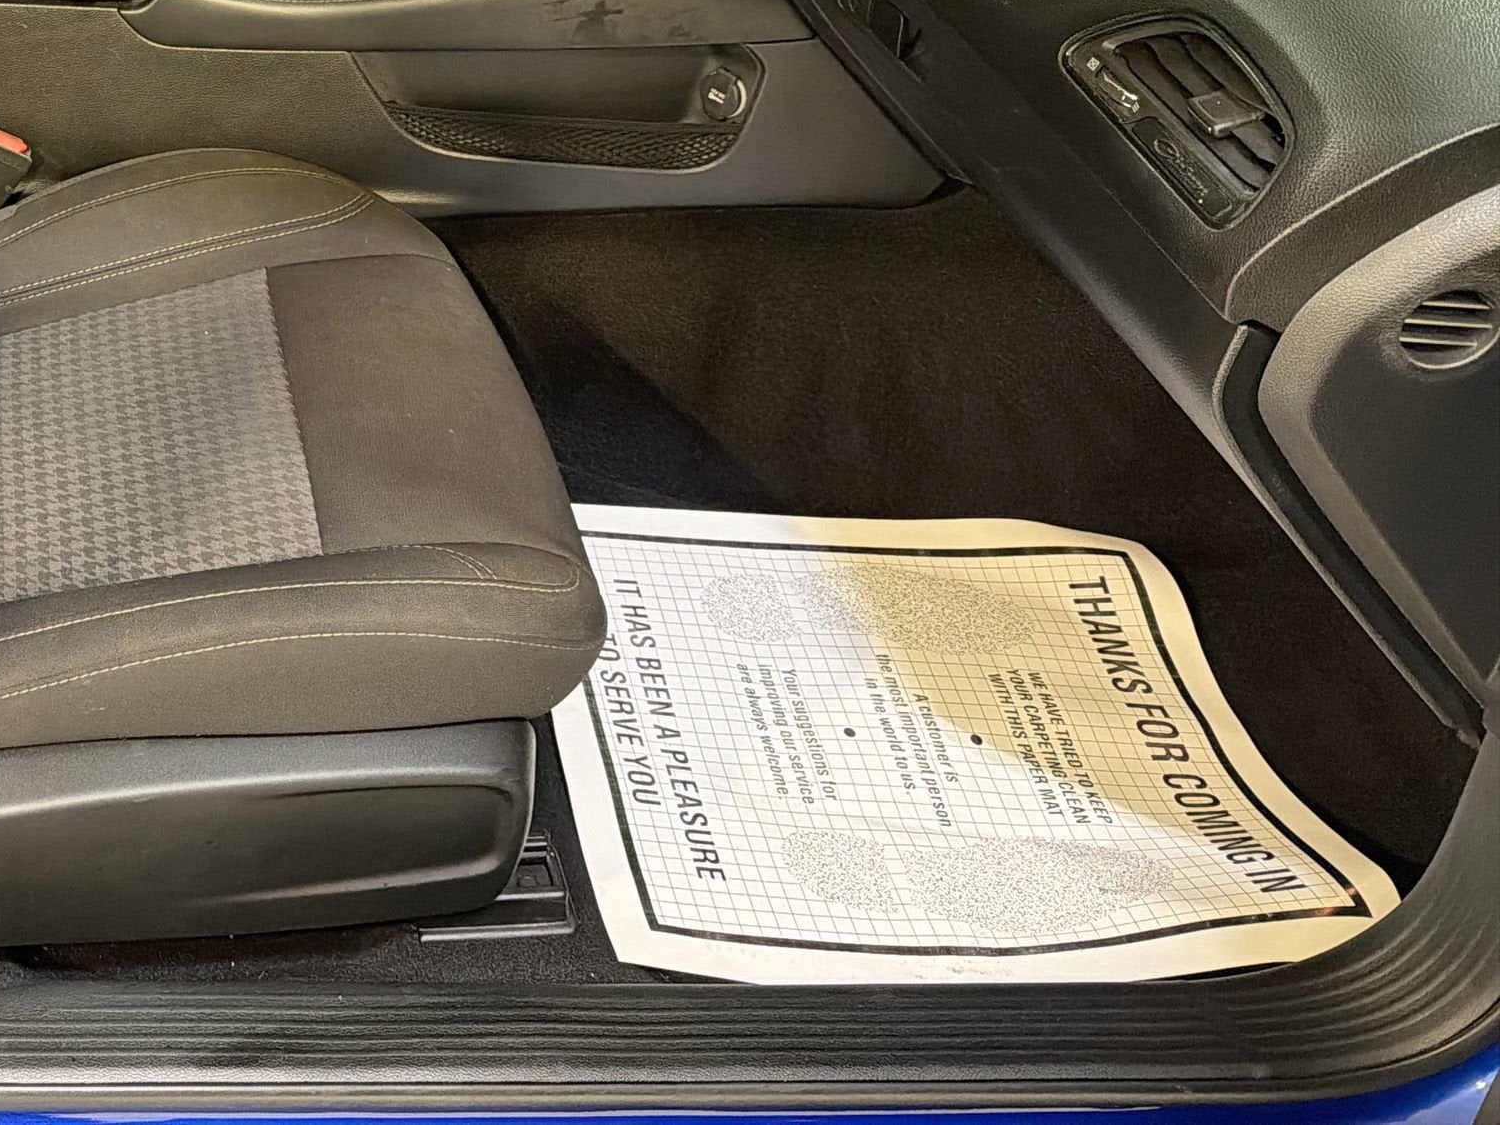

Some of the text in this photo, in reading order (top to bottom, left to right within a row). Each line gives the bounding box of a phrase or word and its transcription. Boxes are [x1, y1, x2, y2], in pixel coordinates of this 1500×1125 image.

[600, 670, 644, 747] SERVE
[623, 755, 662, 806] YOU
[613, 579, 727, 881] IT HAS BEEN A PLEASURE
[736, 663, 789, 800] are always welcome.
[757, 664, 815, 804] improving our service
[781, 668, 837, 801] Your suggestions for
[864, 677, 916, 795] in the world to us.
[875, 654, 952, 827] the most important person
[912, 693, 959, 783] A customer is
[988, 673, 1065, 817] WITH THIS PAPER MAT
[1006, 669, 1092, 824] YOUR CARPETING CLEAN
[1027, 672, 1113, 824] WE HAVE TRIED TO KEEP
[1068, 575, 1306, 893] THANKS FOR COMING IN
